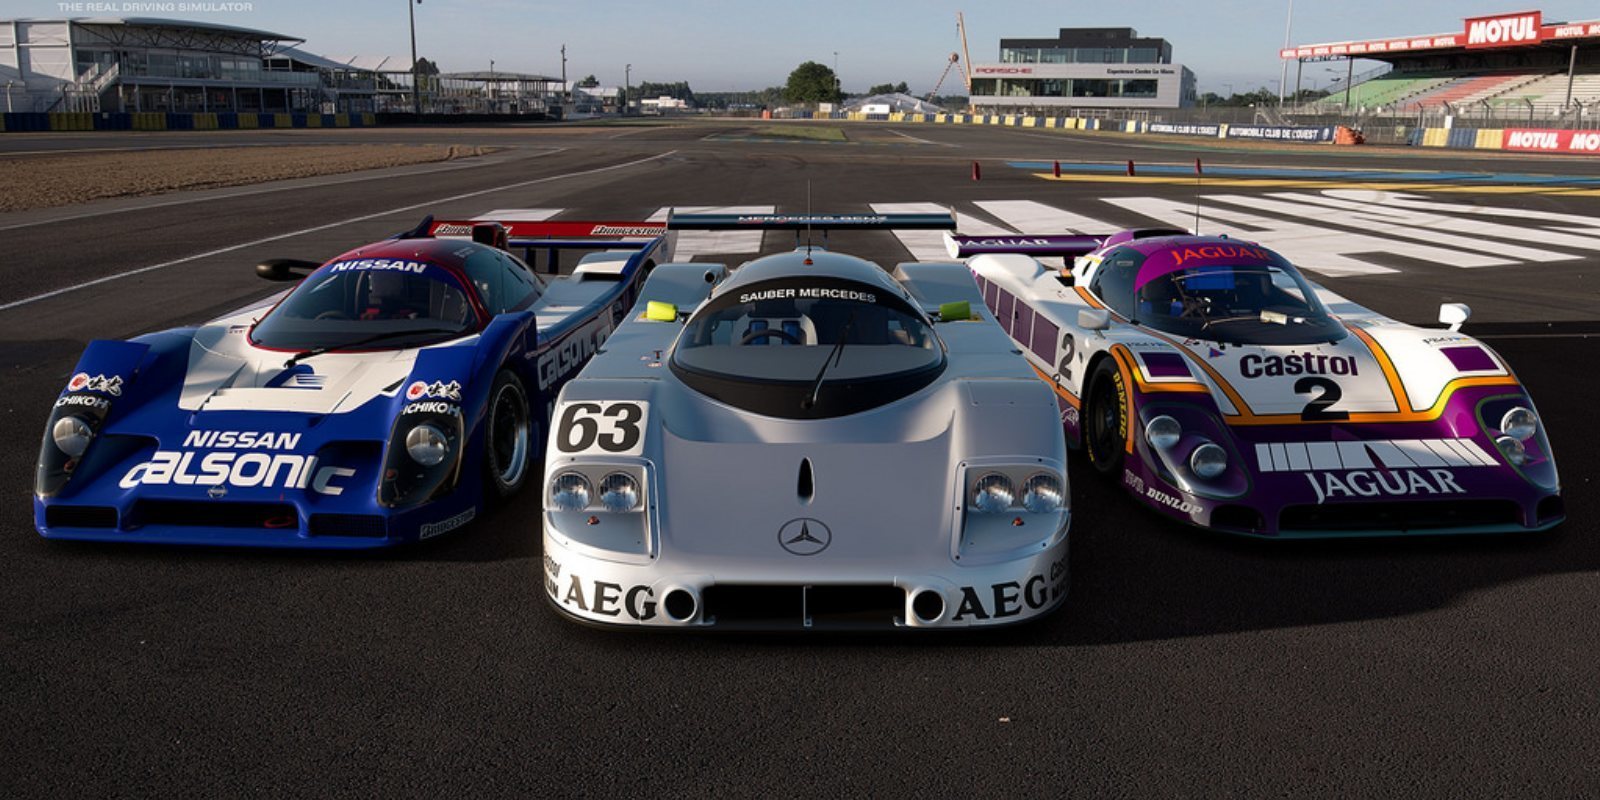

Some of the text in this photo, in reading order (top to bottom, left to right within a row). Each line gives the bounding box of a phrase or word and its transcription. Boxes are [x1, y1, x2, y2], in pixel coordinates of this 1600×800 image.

[1467, 16, 1537, 45] MOTUL
[1554, 26, 1584, 37] MOTUL
[1150, 124, 1177, 133] AUTOMOBILE
[1177, 125, 1189, 134] CLUB
[1189, 126, 1197, 134] DE
[1229, 127, 1318, 139] AUTOMOBILE CLUB DE L'OUEST
[1507, 131, 1559, 149] MOTUL
[331, 259, 427, 274] NISSAN
[1171, 246, 1273, 265] JAGUAR
[740, 287, 876, 302] SAUBER MERCEDES
[1058, 332, 1075, 381] 2
[1239, 352, 1359, 379] Castrol
[1294, 376, 1350, 421] 2
[183, 430, 301, 449] NISSAN
[556, 402, 643, 453] 63
[1304, 468, 1467, 504] JAGUAR
[1146, 487, 1204, 515] DUNLOP
[563, 573, 658, 621] AEG
[951, 574, 1049, 621] AEG
